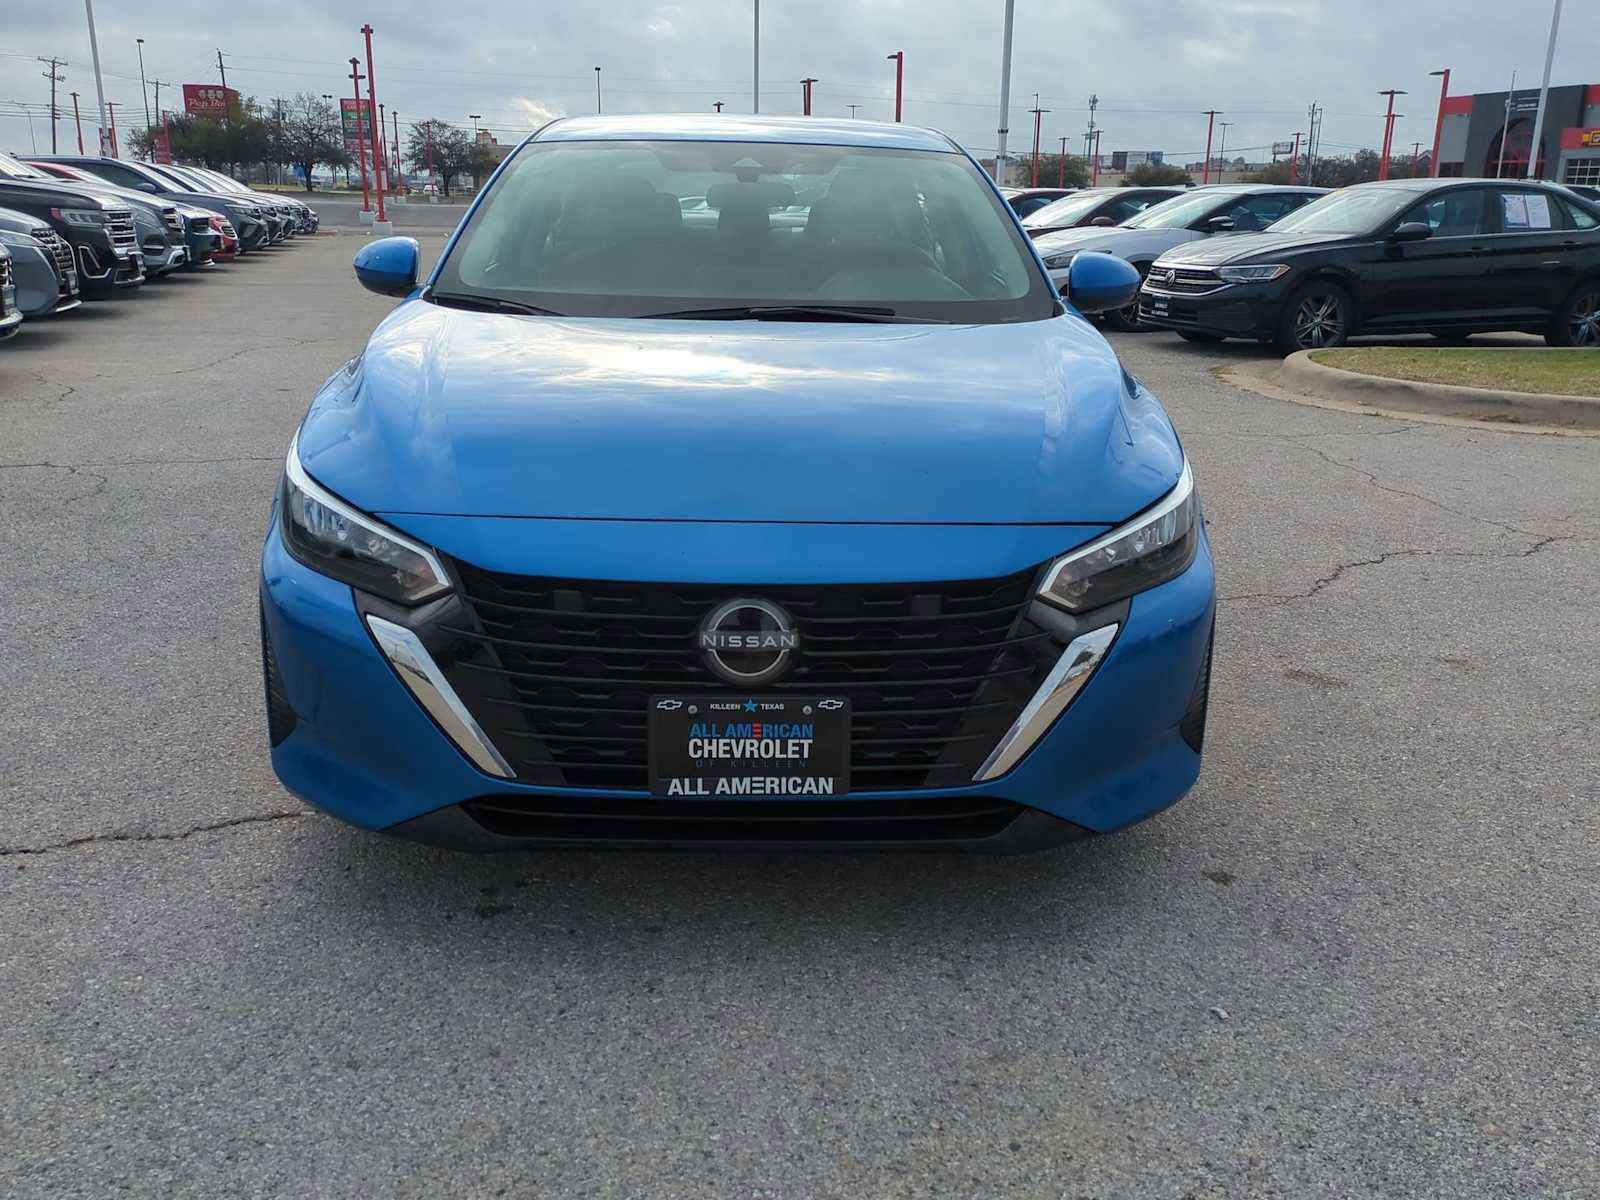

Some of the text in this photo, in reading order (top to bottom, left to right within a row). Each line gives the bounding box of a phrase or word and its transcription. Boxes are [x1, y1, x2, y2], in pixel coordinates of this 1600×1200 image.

[702, 634, 795, 648] NISSAN
[690, 723, 813, 738] ALL AMERICAN
[688, 739, 813, 758] CHEVROLET
[696, 759, 806, 768] OF KILLEEN
[667, 776, 833, 795] ALL AMERICAN
